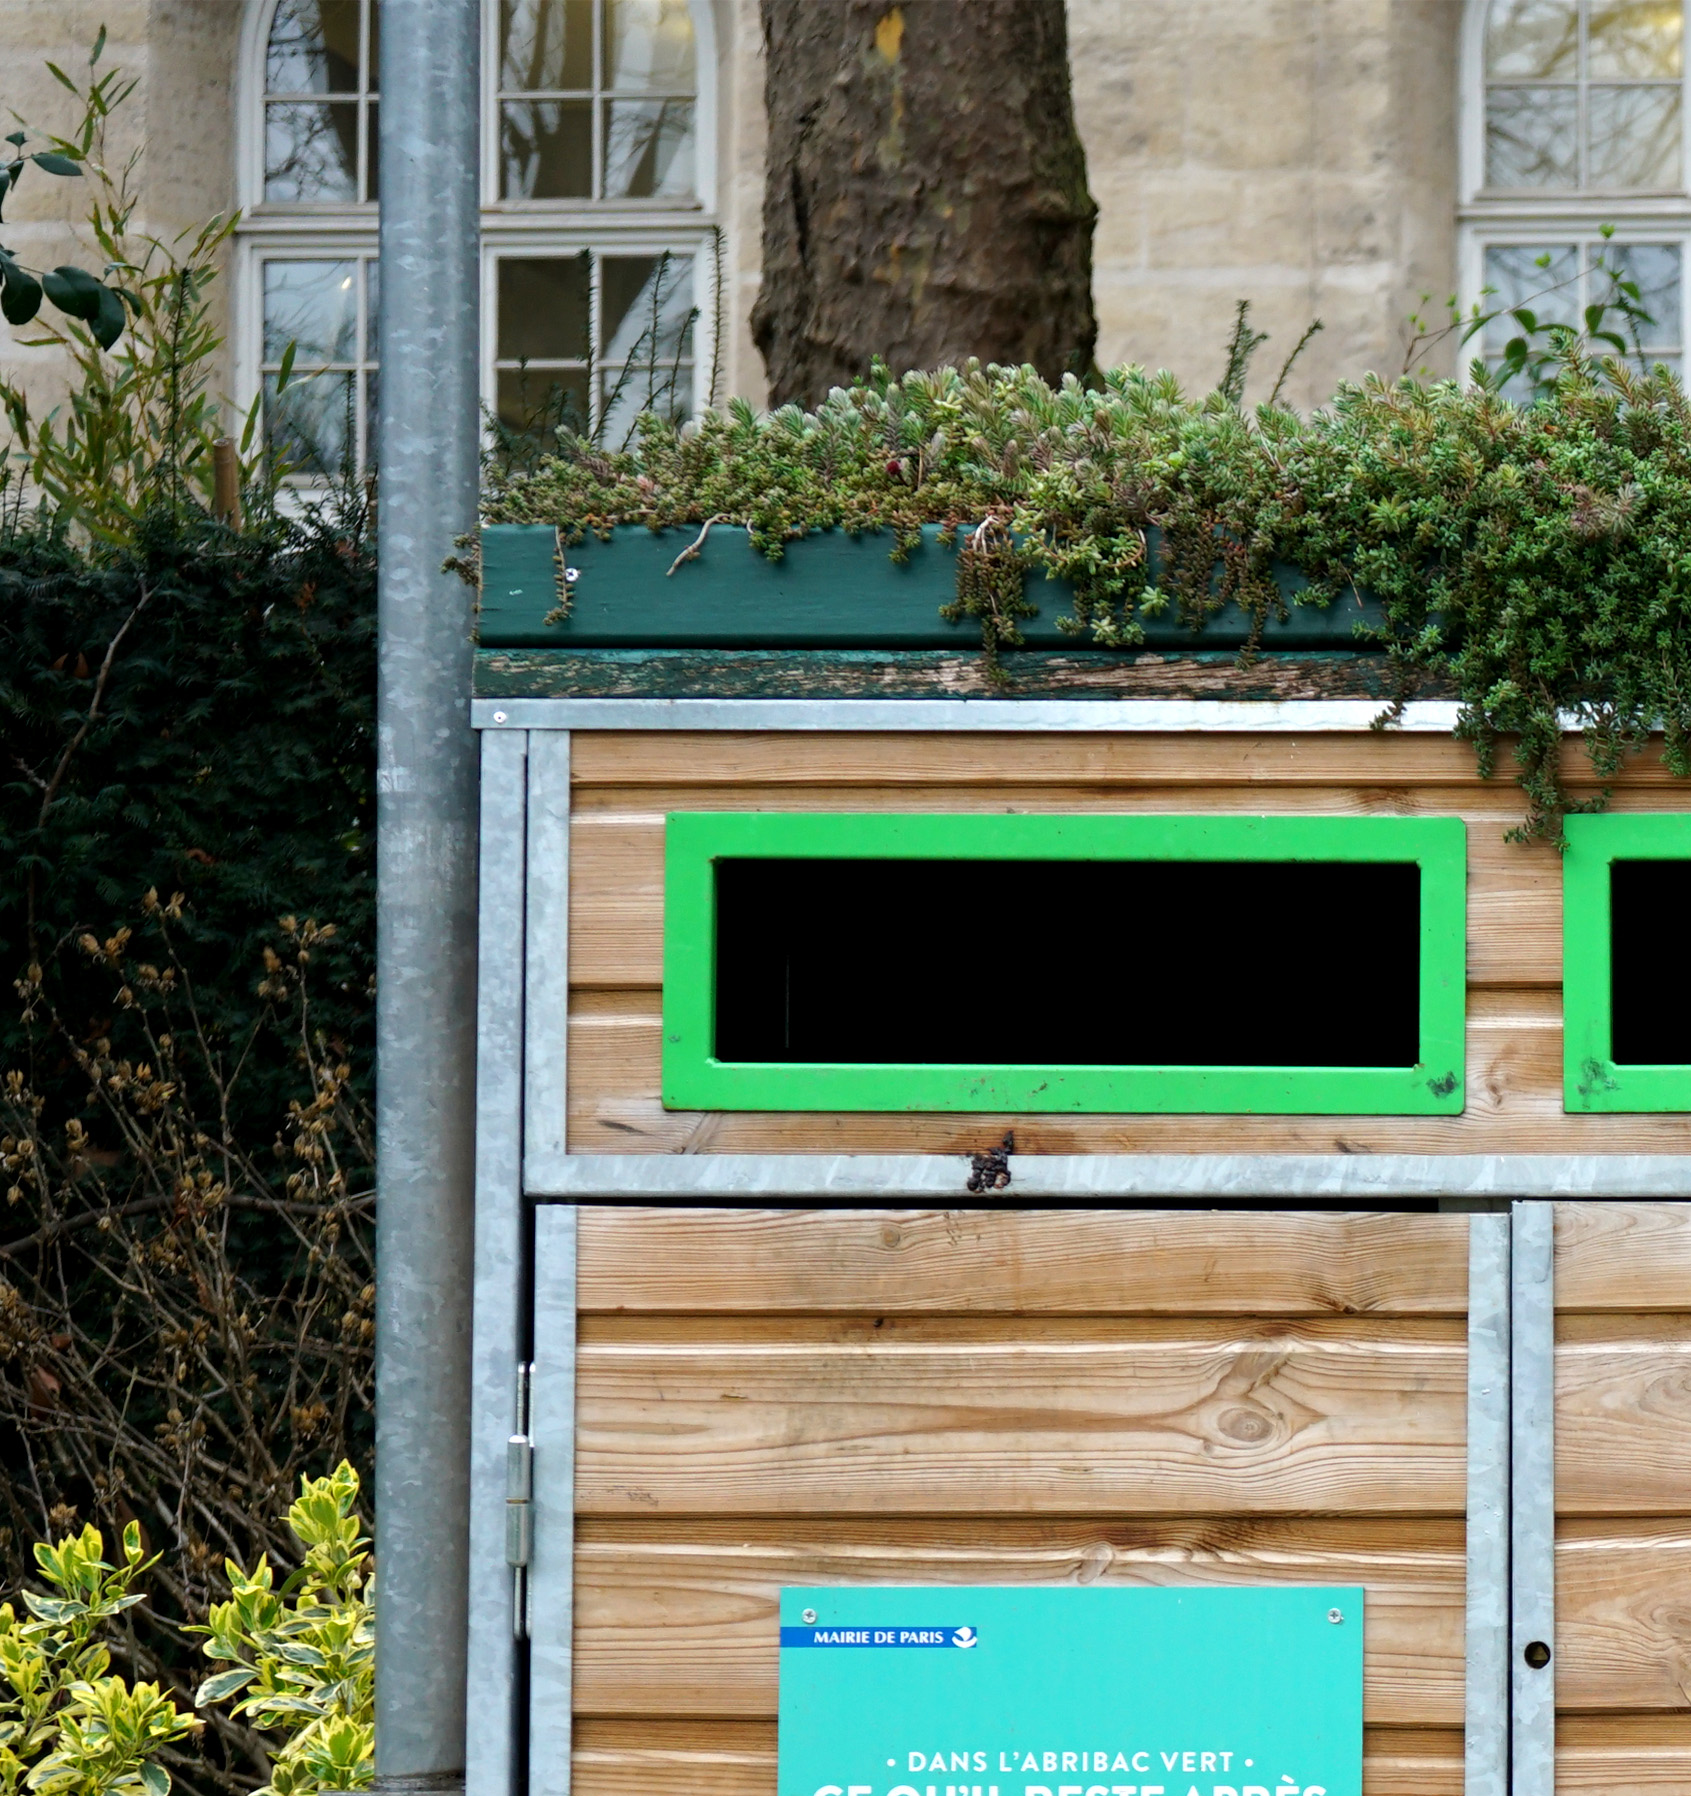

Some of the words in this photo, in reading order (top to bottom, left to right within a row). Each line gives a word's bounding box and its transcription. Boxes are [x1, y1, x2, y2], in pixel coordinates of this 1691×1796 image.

[813, 1631, 870, 1644] MAIRIE
[874, 1631, 896, 1644] DE
[899, 1631, 944, 1644] PARIS
[908, 1751, 988, 1773] DANS
[999, 1751, 1150, 1773] L'ABRIBAC
[1159, 1751, 1234, 1773] VERT
